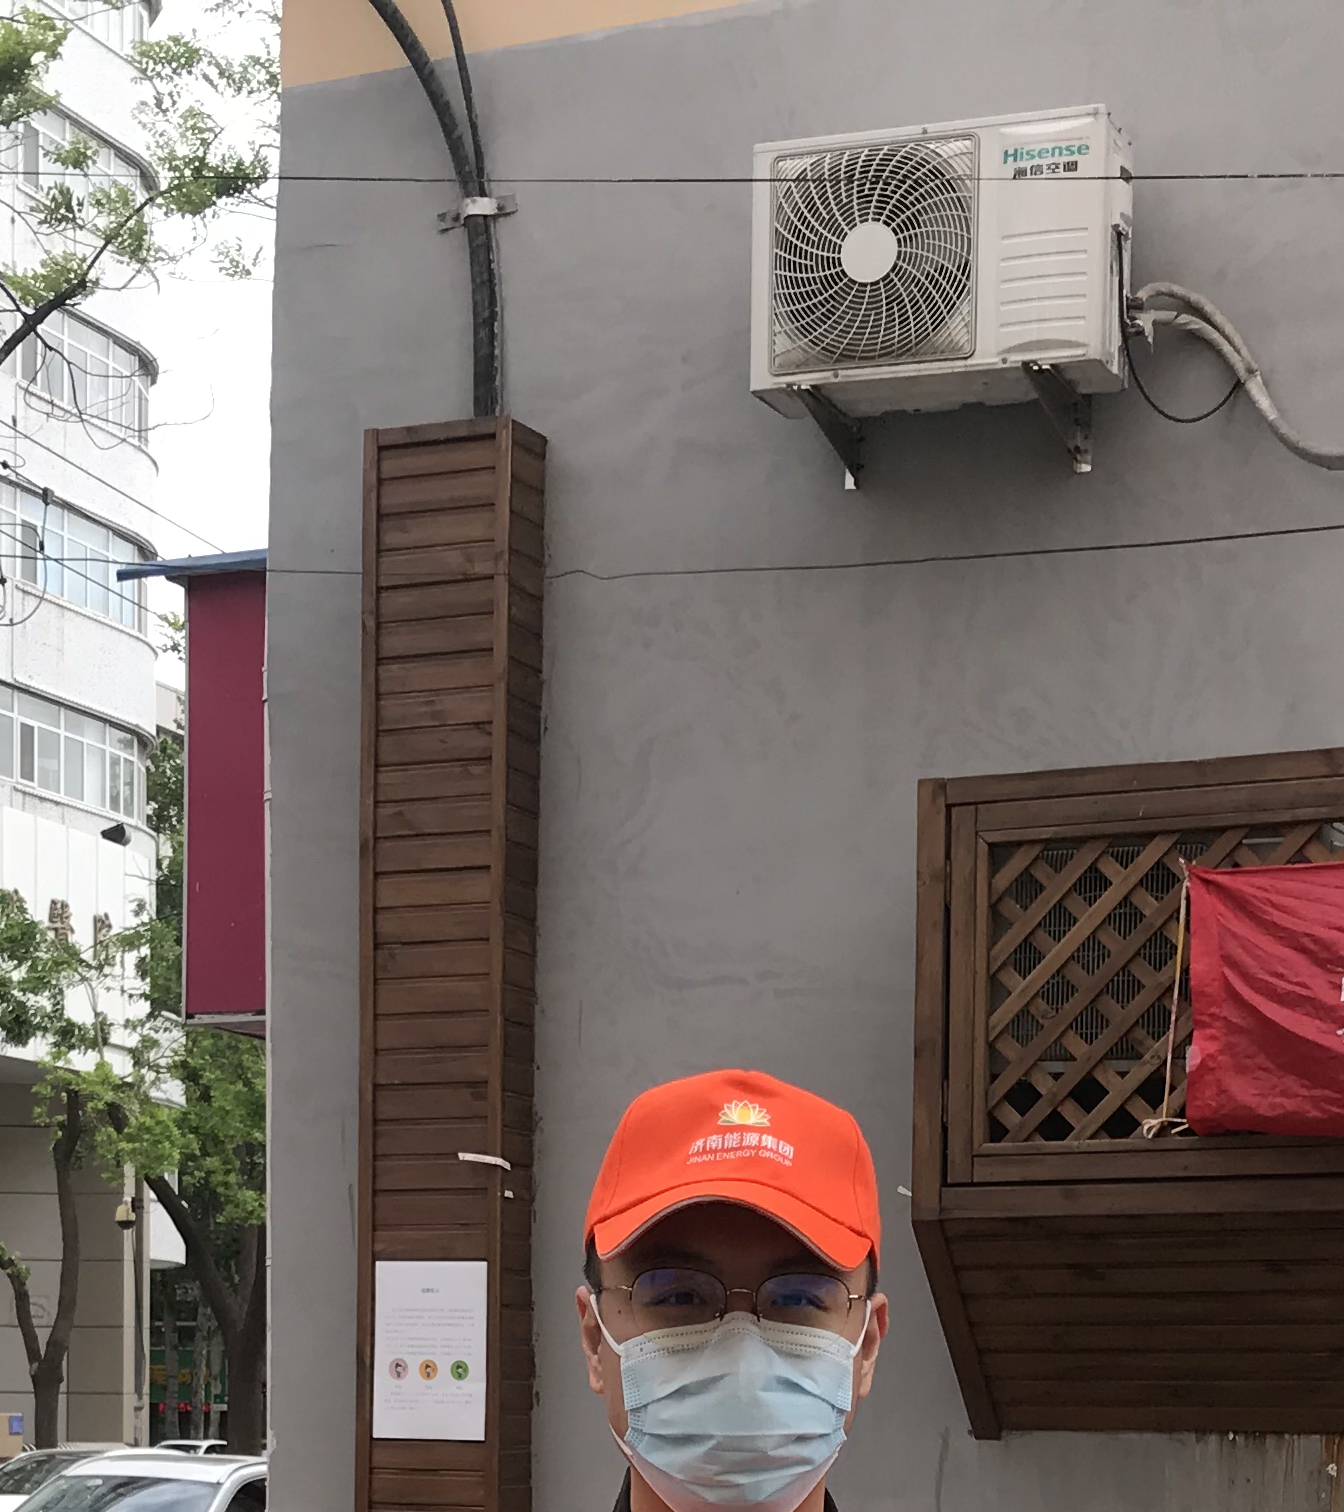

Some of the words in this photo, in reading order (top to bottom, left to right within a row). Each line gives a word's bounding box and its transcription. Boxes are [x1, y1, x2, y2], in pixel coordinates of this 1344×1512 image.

[1003, 143, 1090, 164] Hisense
[688, 1132, 795, 1160] 济南能源集团
[686, 1153, 715, 1165] JINAN
[716, 1149, 758, 1161] ENERGY
[758, 1150, 793, 1167] GROUP
